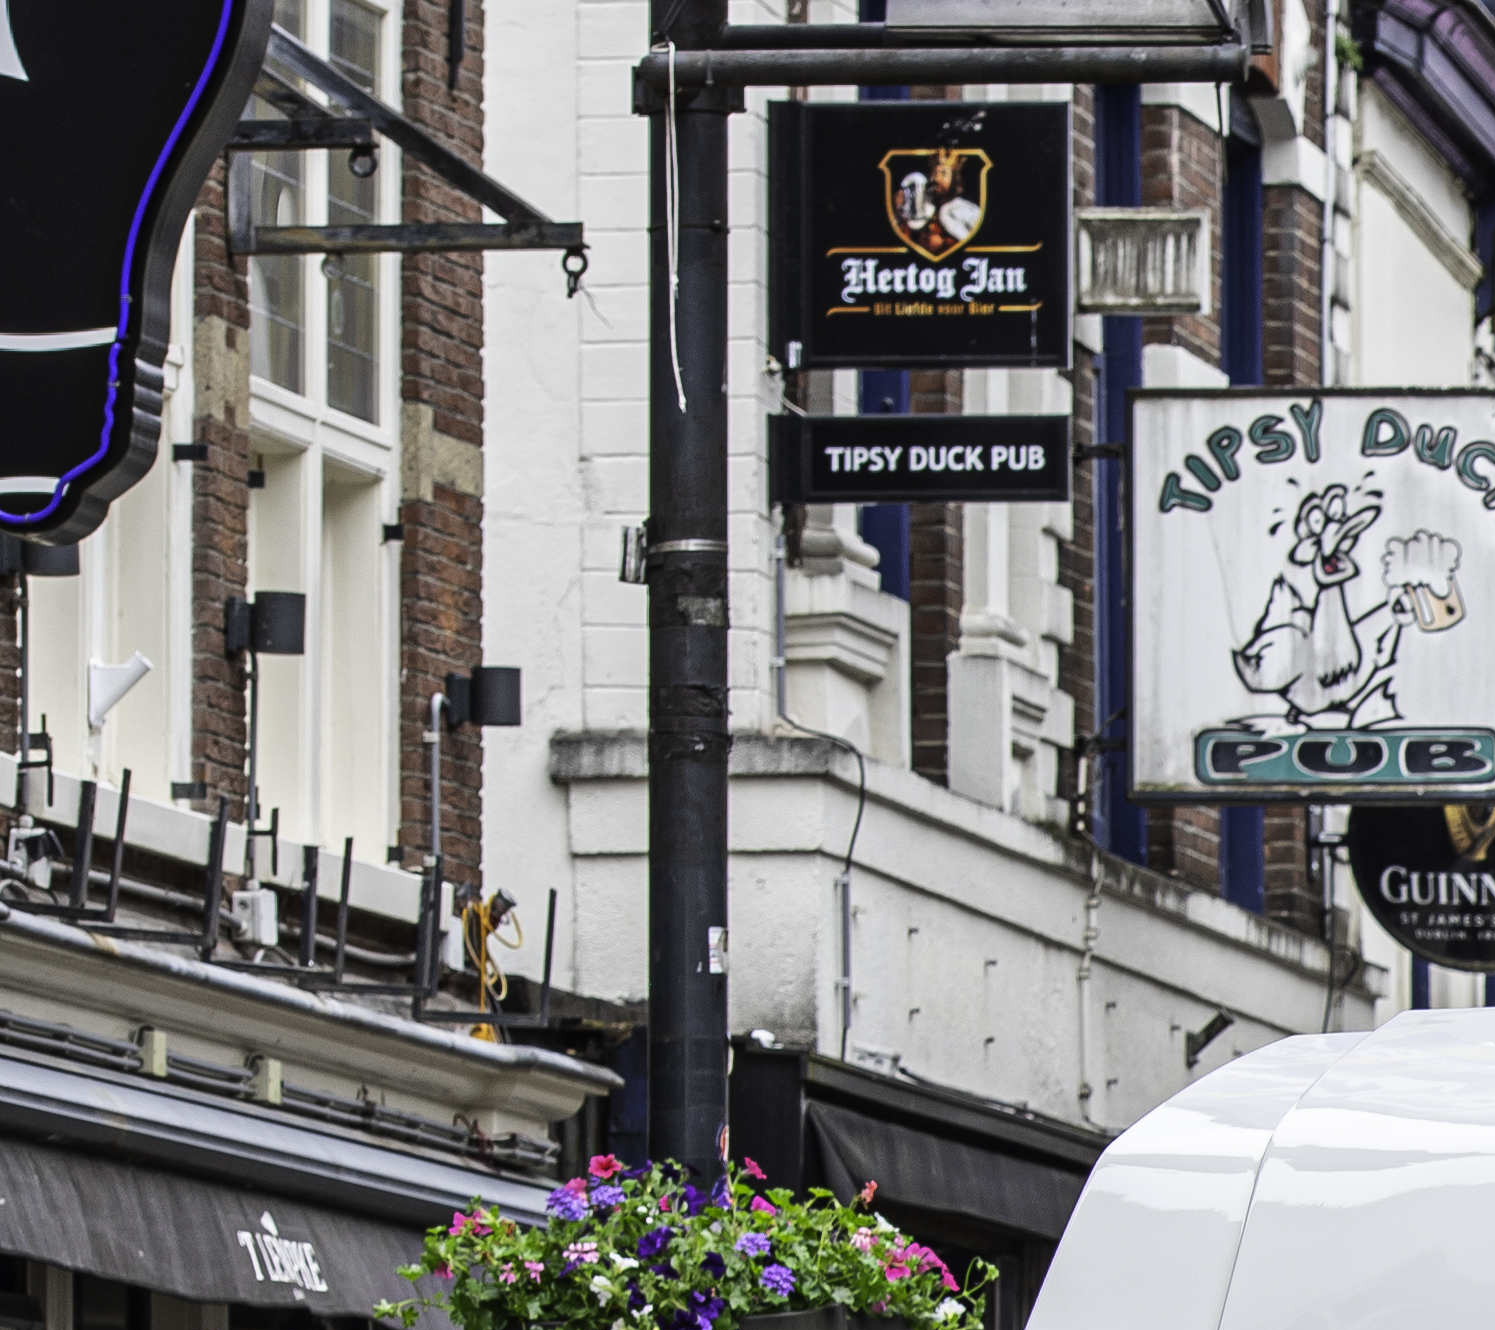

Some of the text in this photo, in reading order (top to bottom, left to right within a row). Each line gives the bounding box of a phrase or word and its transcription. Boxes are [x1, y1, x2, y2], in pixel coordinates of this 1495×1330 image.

[841, 256, 1028, 303] Hertog Jan
[825, 446, 1046, 472] TIPSY DUCK PUB
[1158, 398, 1323, 513] TIPSY
